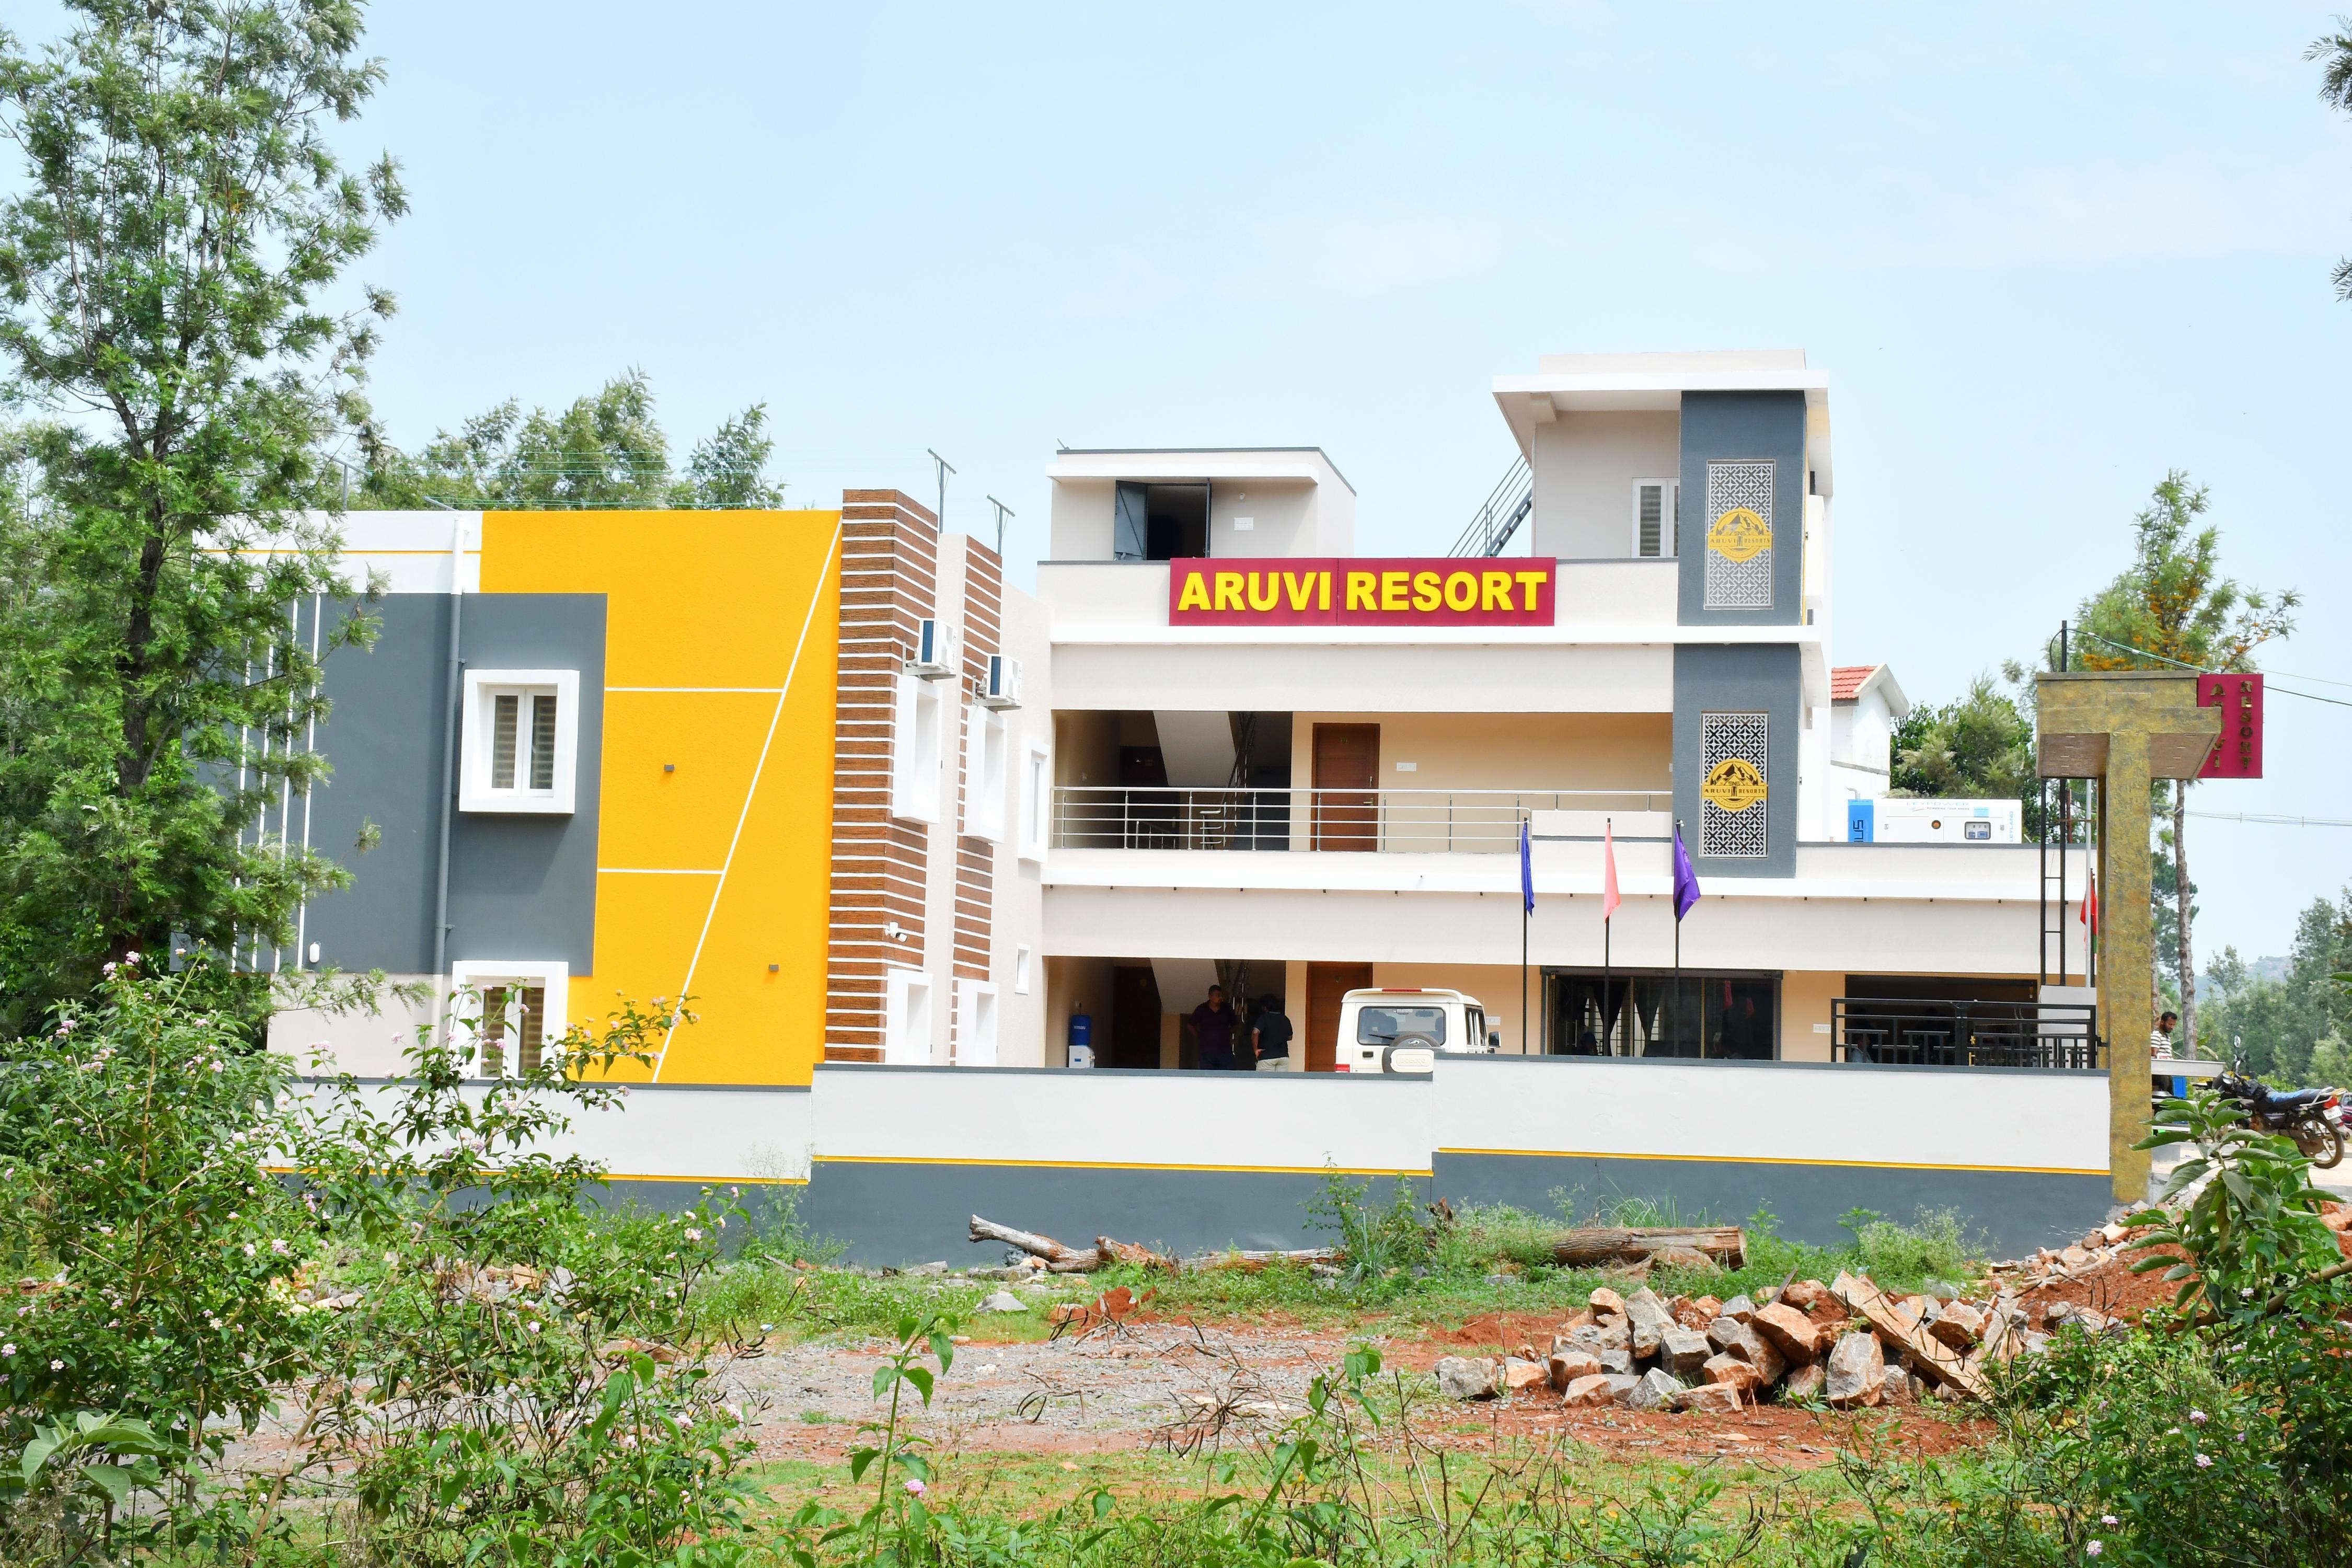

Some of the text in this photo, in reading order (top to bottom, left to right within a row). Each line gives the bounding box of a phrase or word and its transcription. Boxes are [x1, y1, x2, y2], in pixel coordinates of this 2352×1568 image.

[1177, 571, 1548, 612] ARUVI RESORT
[2210, 683, 2226, 768] AVI
[2240, 681, 2253, 768] RESORT
